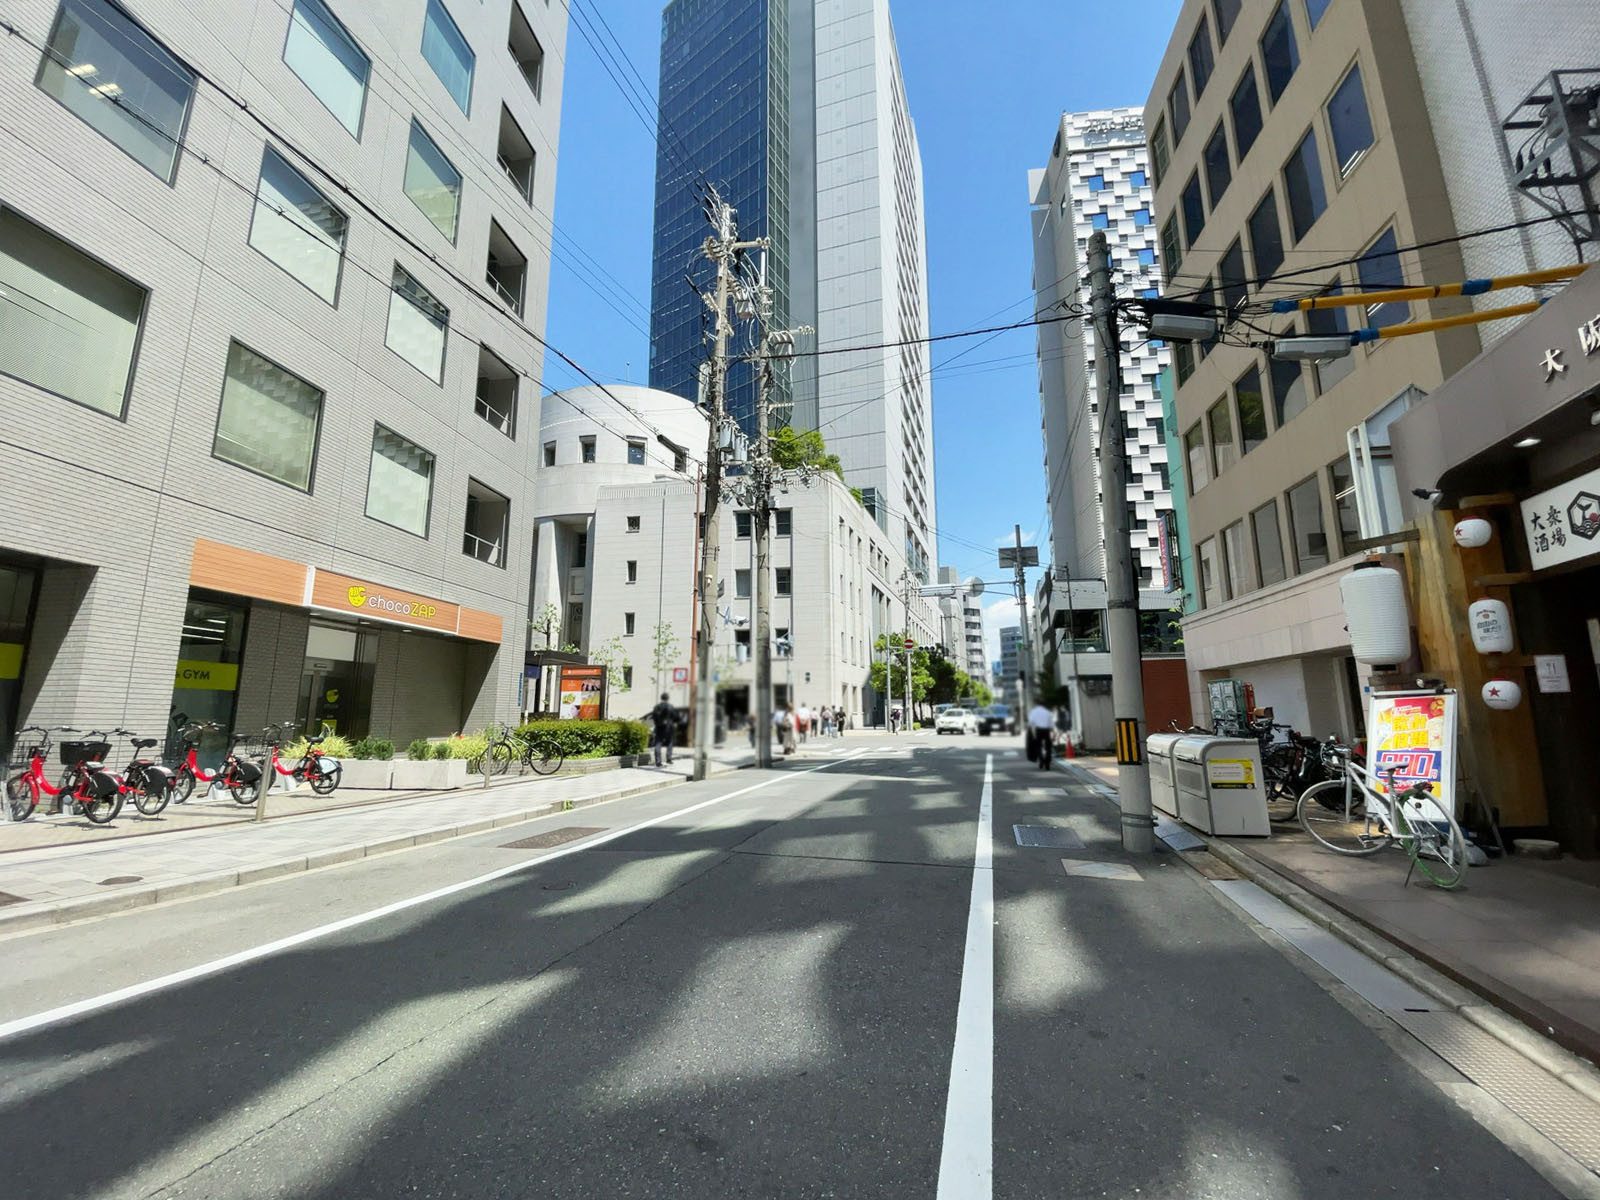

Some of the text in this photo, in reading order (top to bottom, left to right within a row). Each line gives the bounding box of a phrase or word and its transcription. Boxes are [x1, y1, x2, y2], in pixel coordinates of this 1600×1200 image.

[1531, 505, 1562, 532] 大衆
[1534, 527, 1567, 553] 酒場
[368, 595, 436, 619] chocoZAP
[183, 669, 210, 680] GYM
